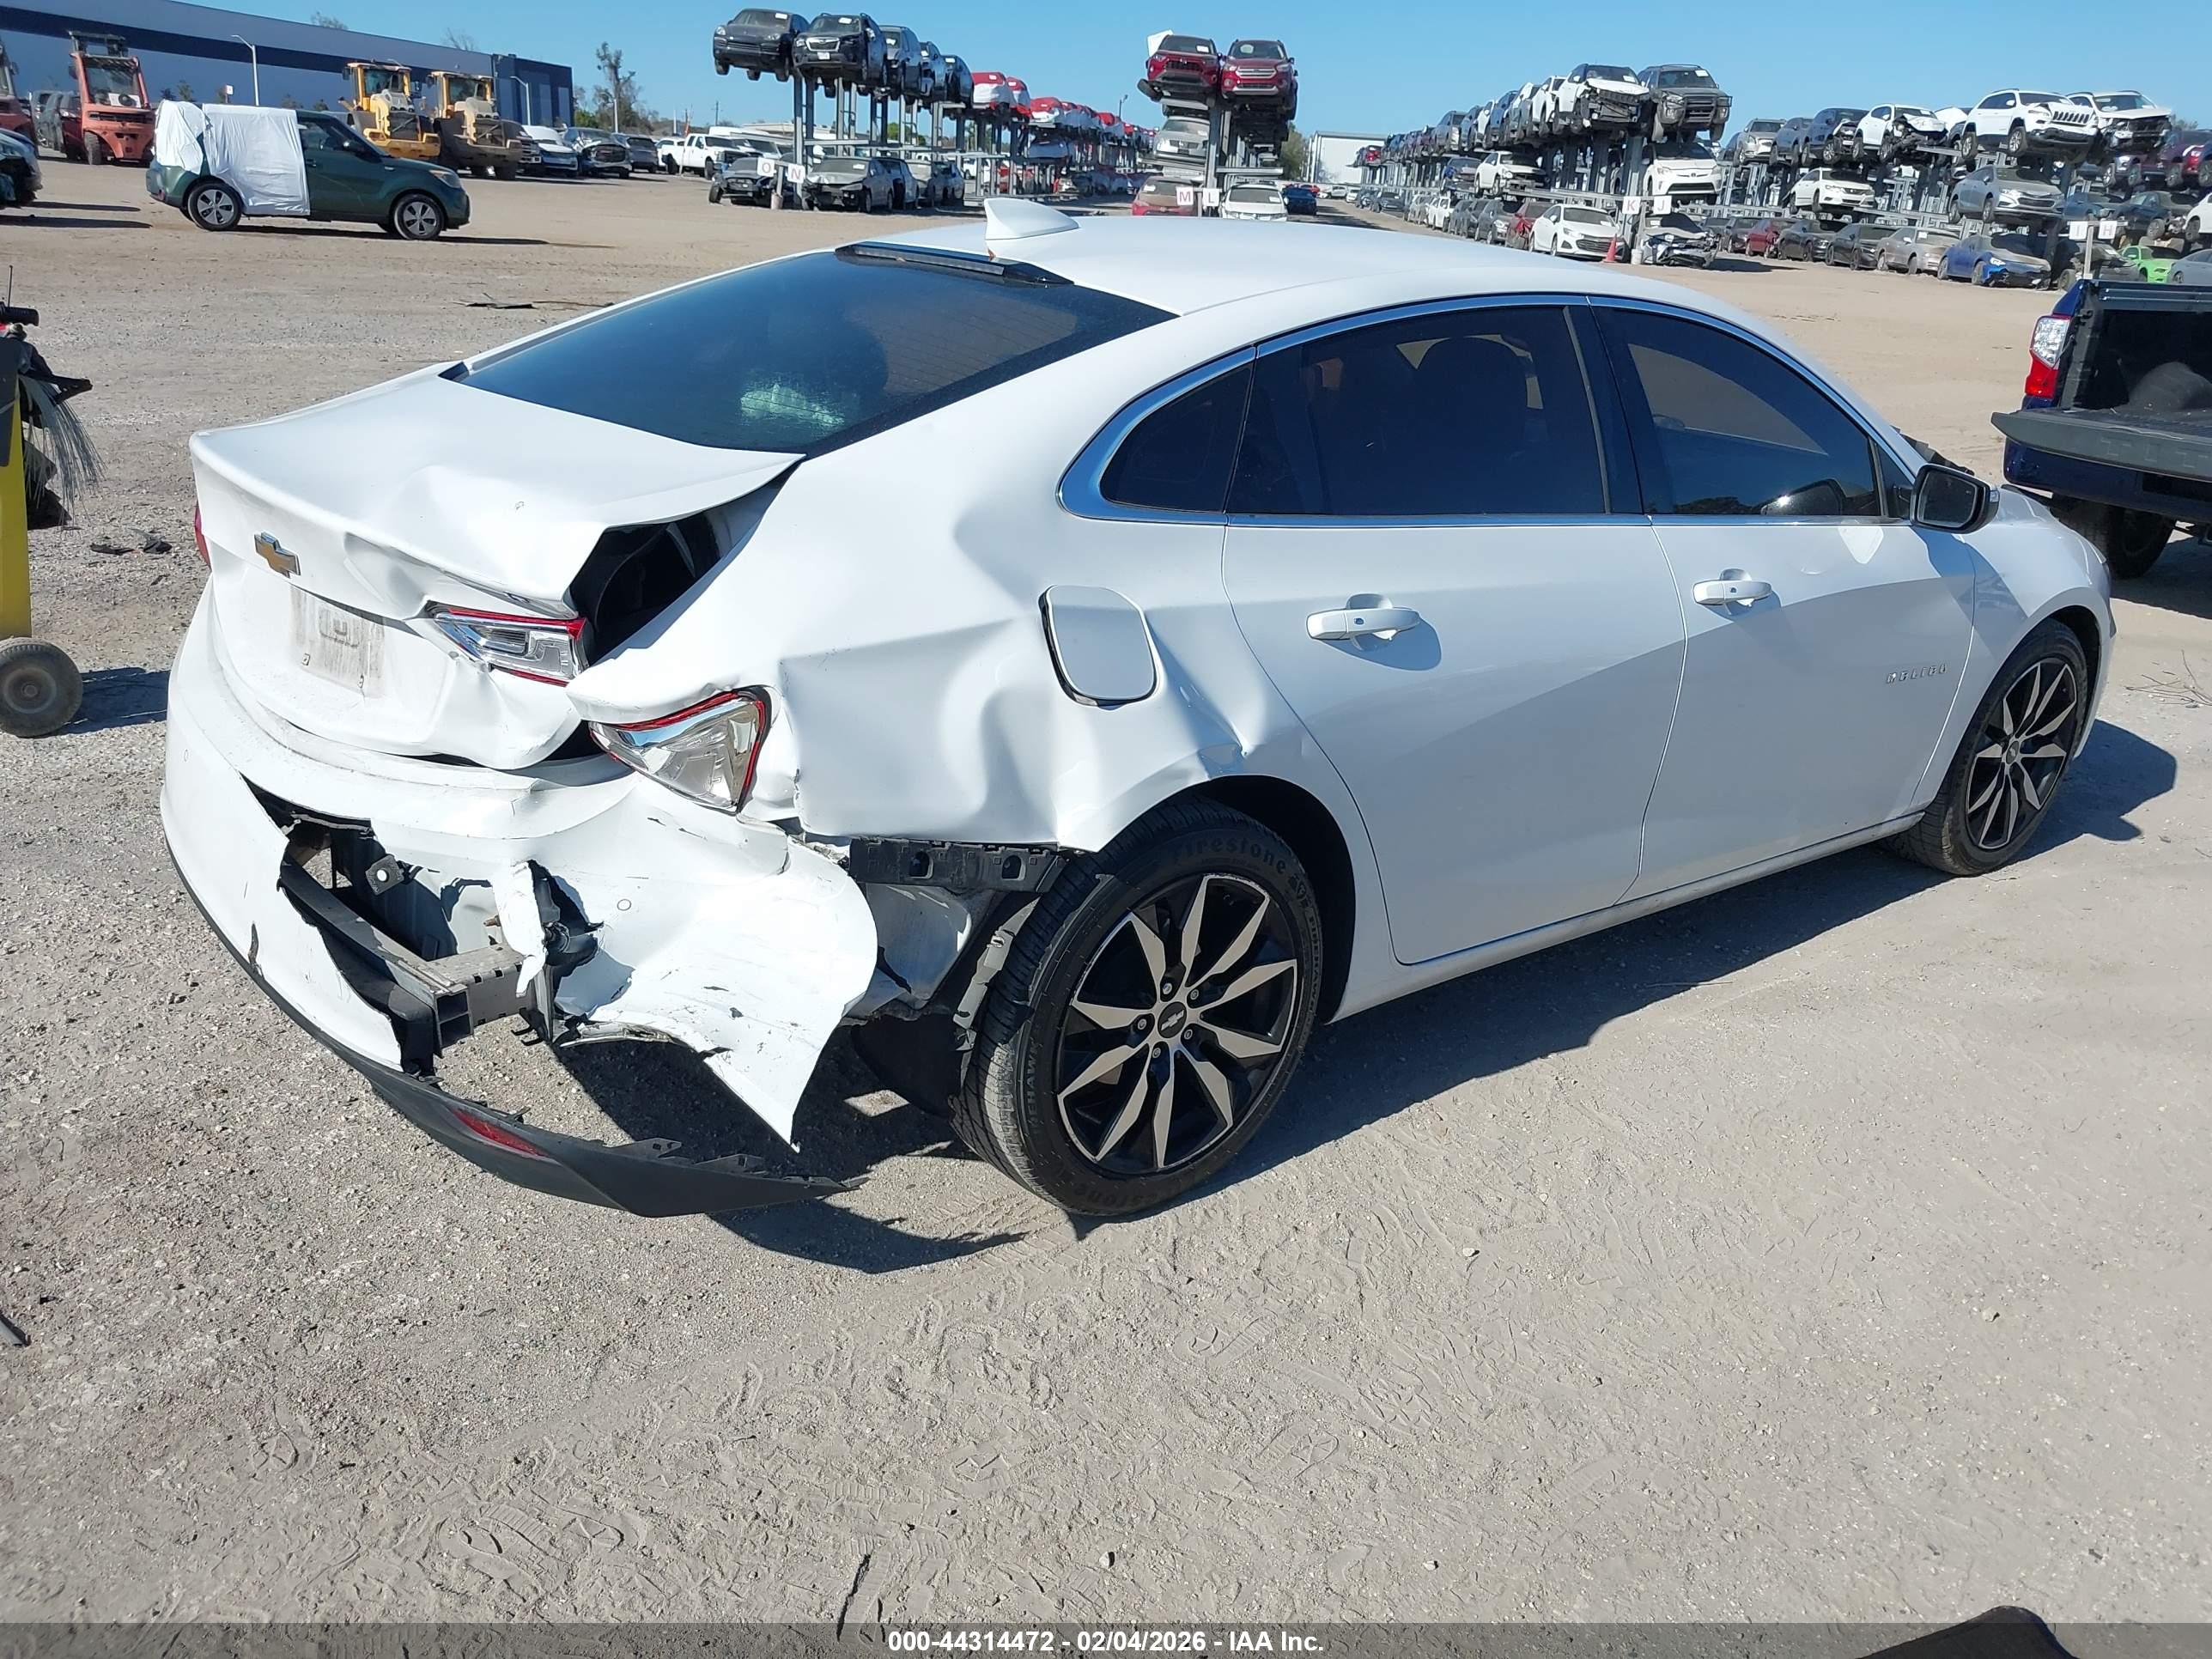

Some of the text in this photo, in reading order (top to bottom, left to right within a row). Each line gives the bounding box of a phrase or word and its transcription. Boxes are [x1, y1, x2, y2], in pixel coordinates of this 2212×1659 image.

[762, 161, 772, 173] O
[790, 167, 802, 180] N
[1179, 191, 1192, 203] M
[1208, 191, 1215, 204] L
[1626, 199, 1636, 211] K
[1656, 199, 1665, 211] J
[2103, 225, 2112, 236] H
